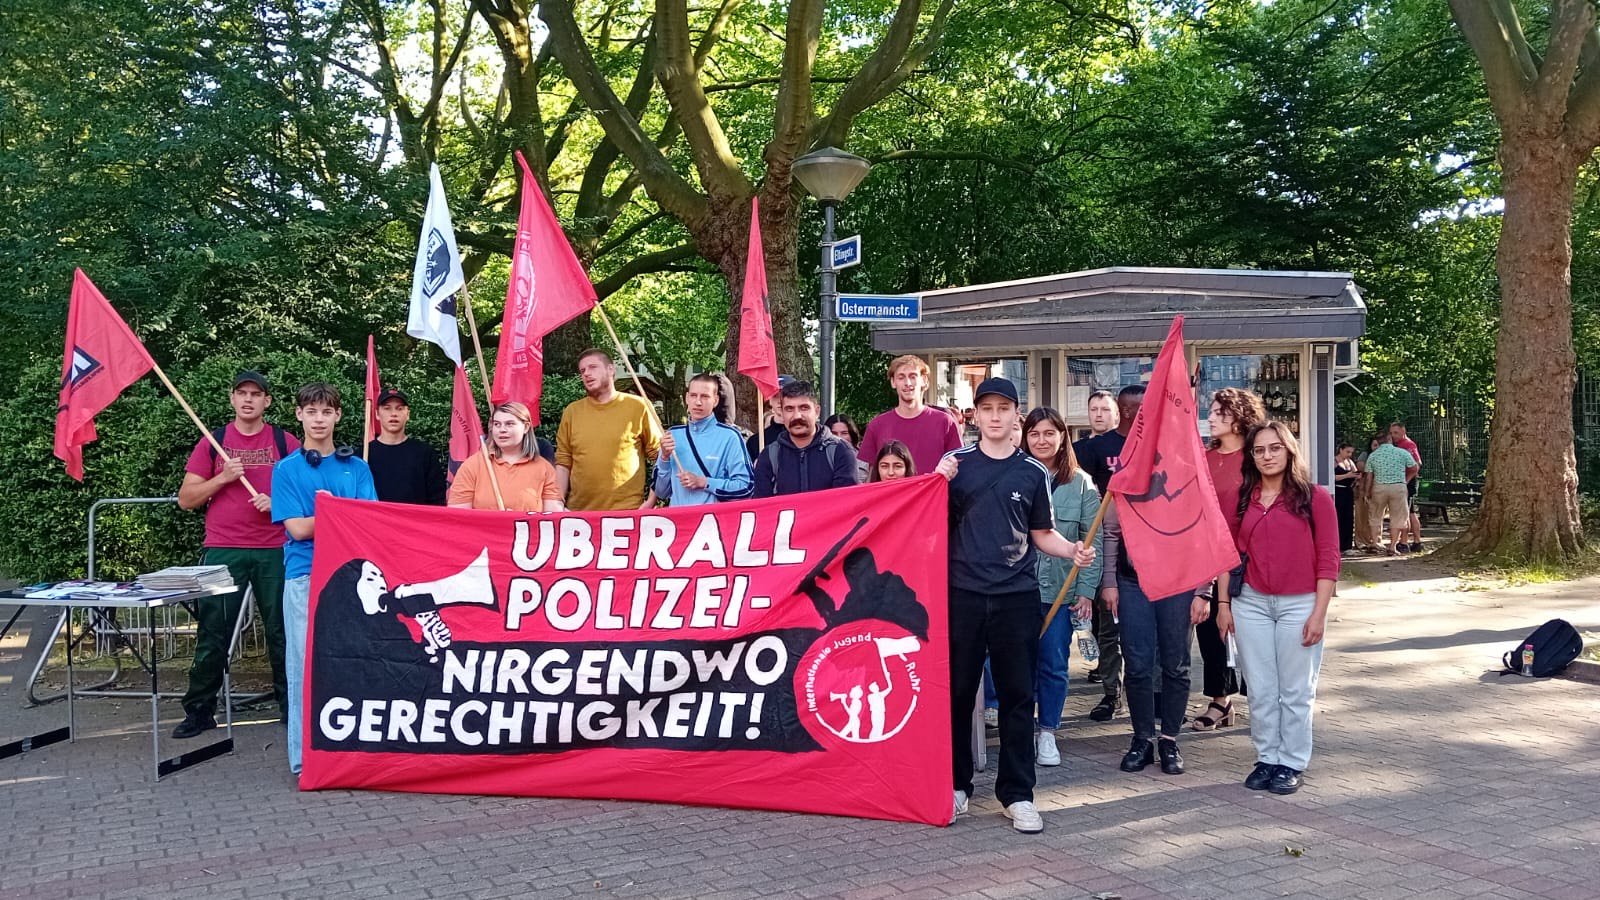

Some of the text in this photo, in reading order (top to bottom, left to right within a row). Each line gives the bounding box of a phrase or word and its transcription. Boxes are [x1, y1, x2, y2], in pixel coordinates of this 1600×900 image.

[842, 302, 911, 316] Ostermannstr.
[505, 574, 772, 631] POLIZEI-
[442, 636, 787, 695] NIRGENDWO
[805, 632, 921, 712] Internationale Jugend Ruhr
[319, 692, 765, 745] GERECHTIGKEIT!
